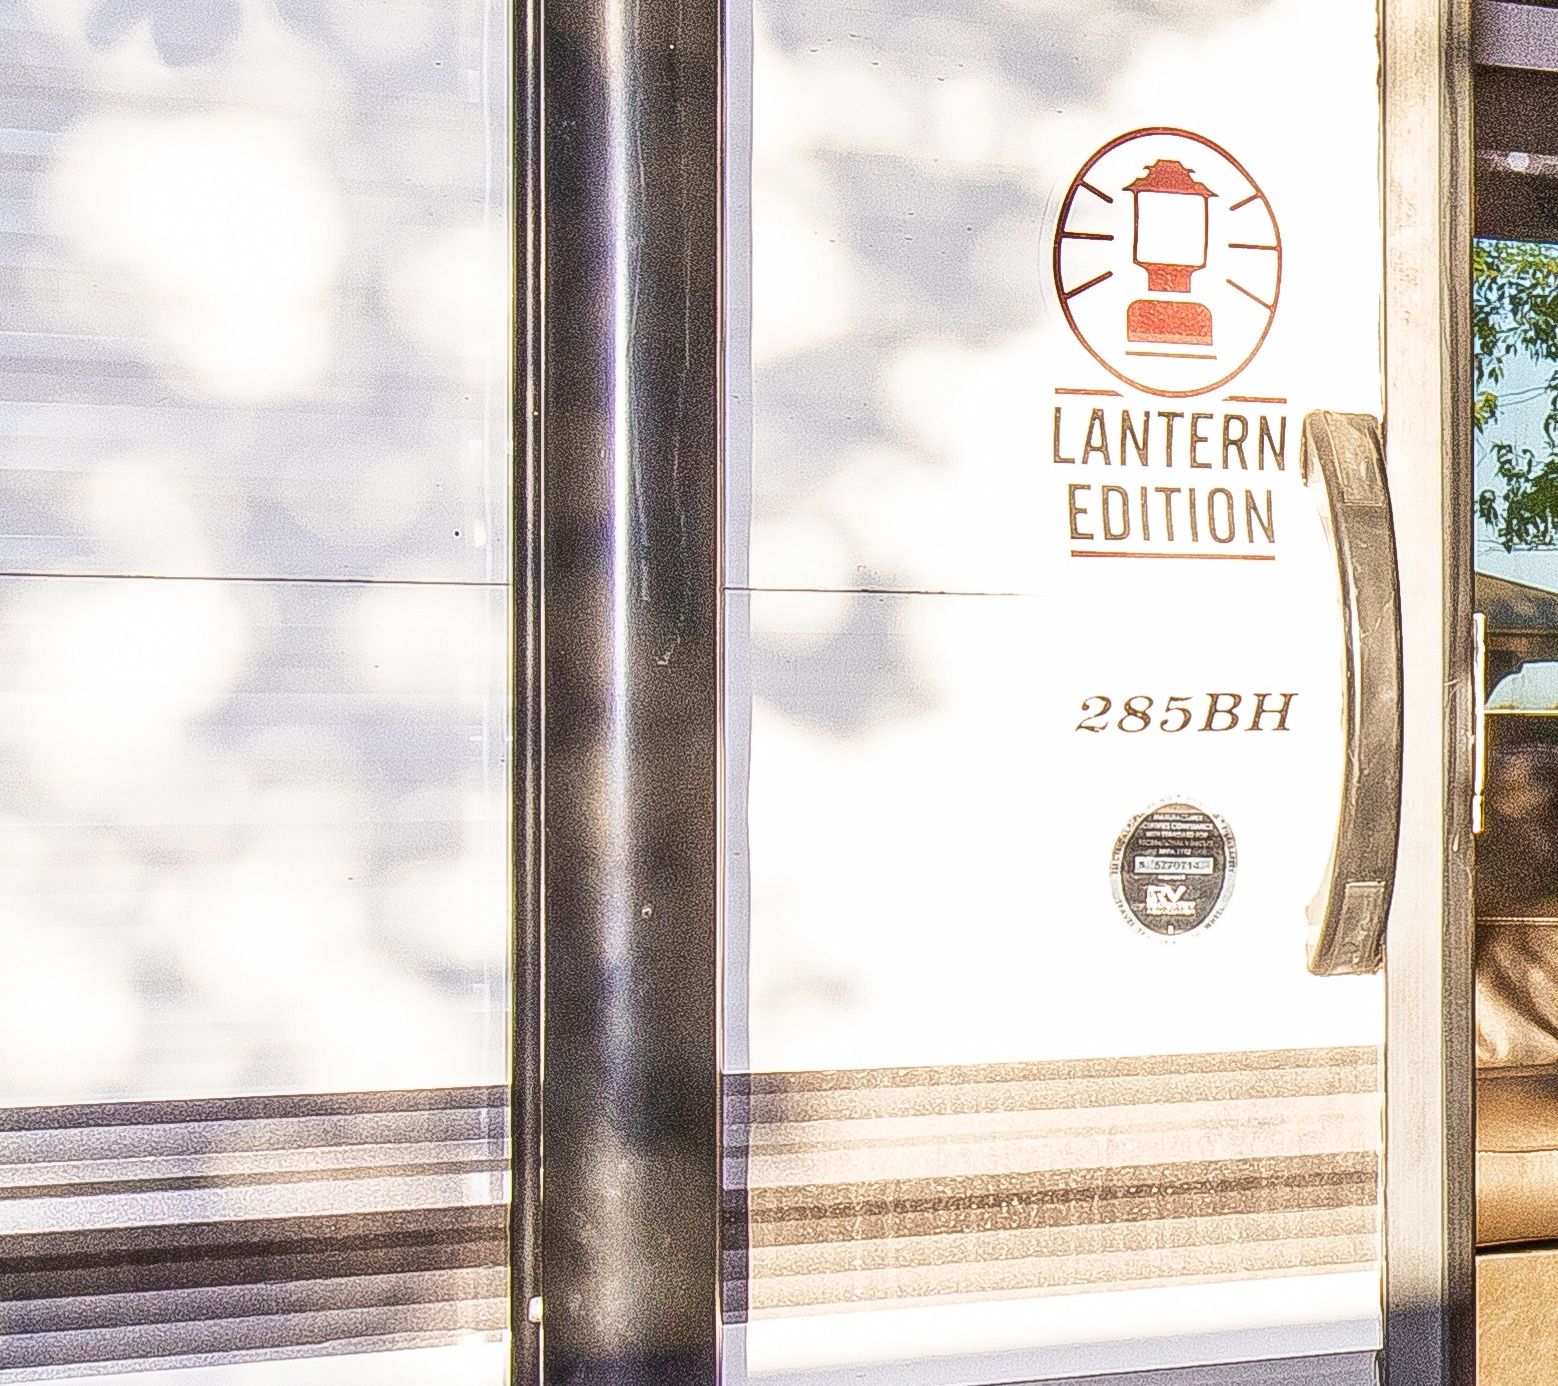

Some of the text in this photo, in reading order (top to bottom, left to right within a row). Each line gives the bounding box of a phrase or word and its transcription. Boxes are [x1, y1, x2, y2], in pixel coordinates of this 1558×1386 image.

[1053, 406, 1287, 471] LANTERN
[1068, 483, 1276, 544] EDITION
[1075, 692, 1300, 733] 285BH
